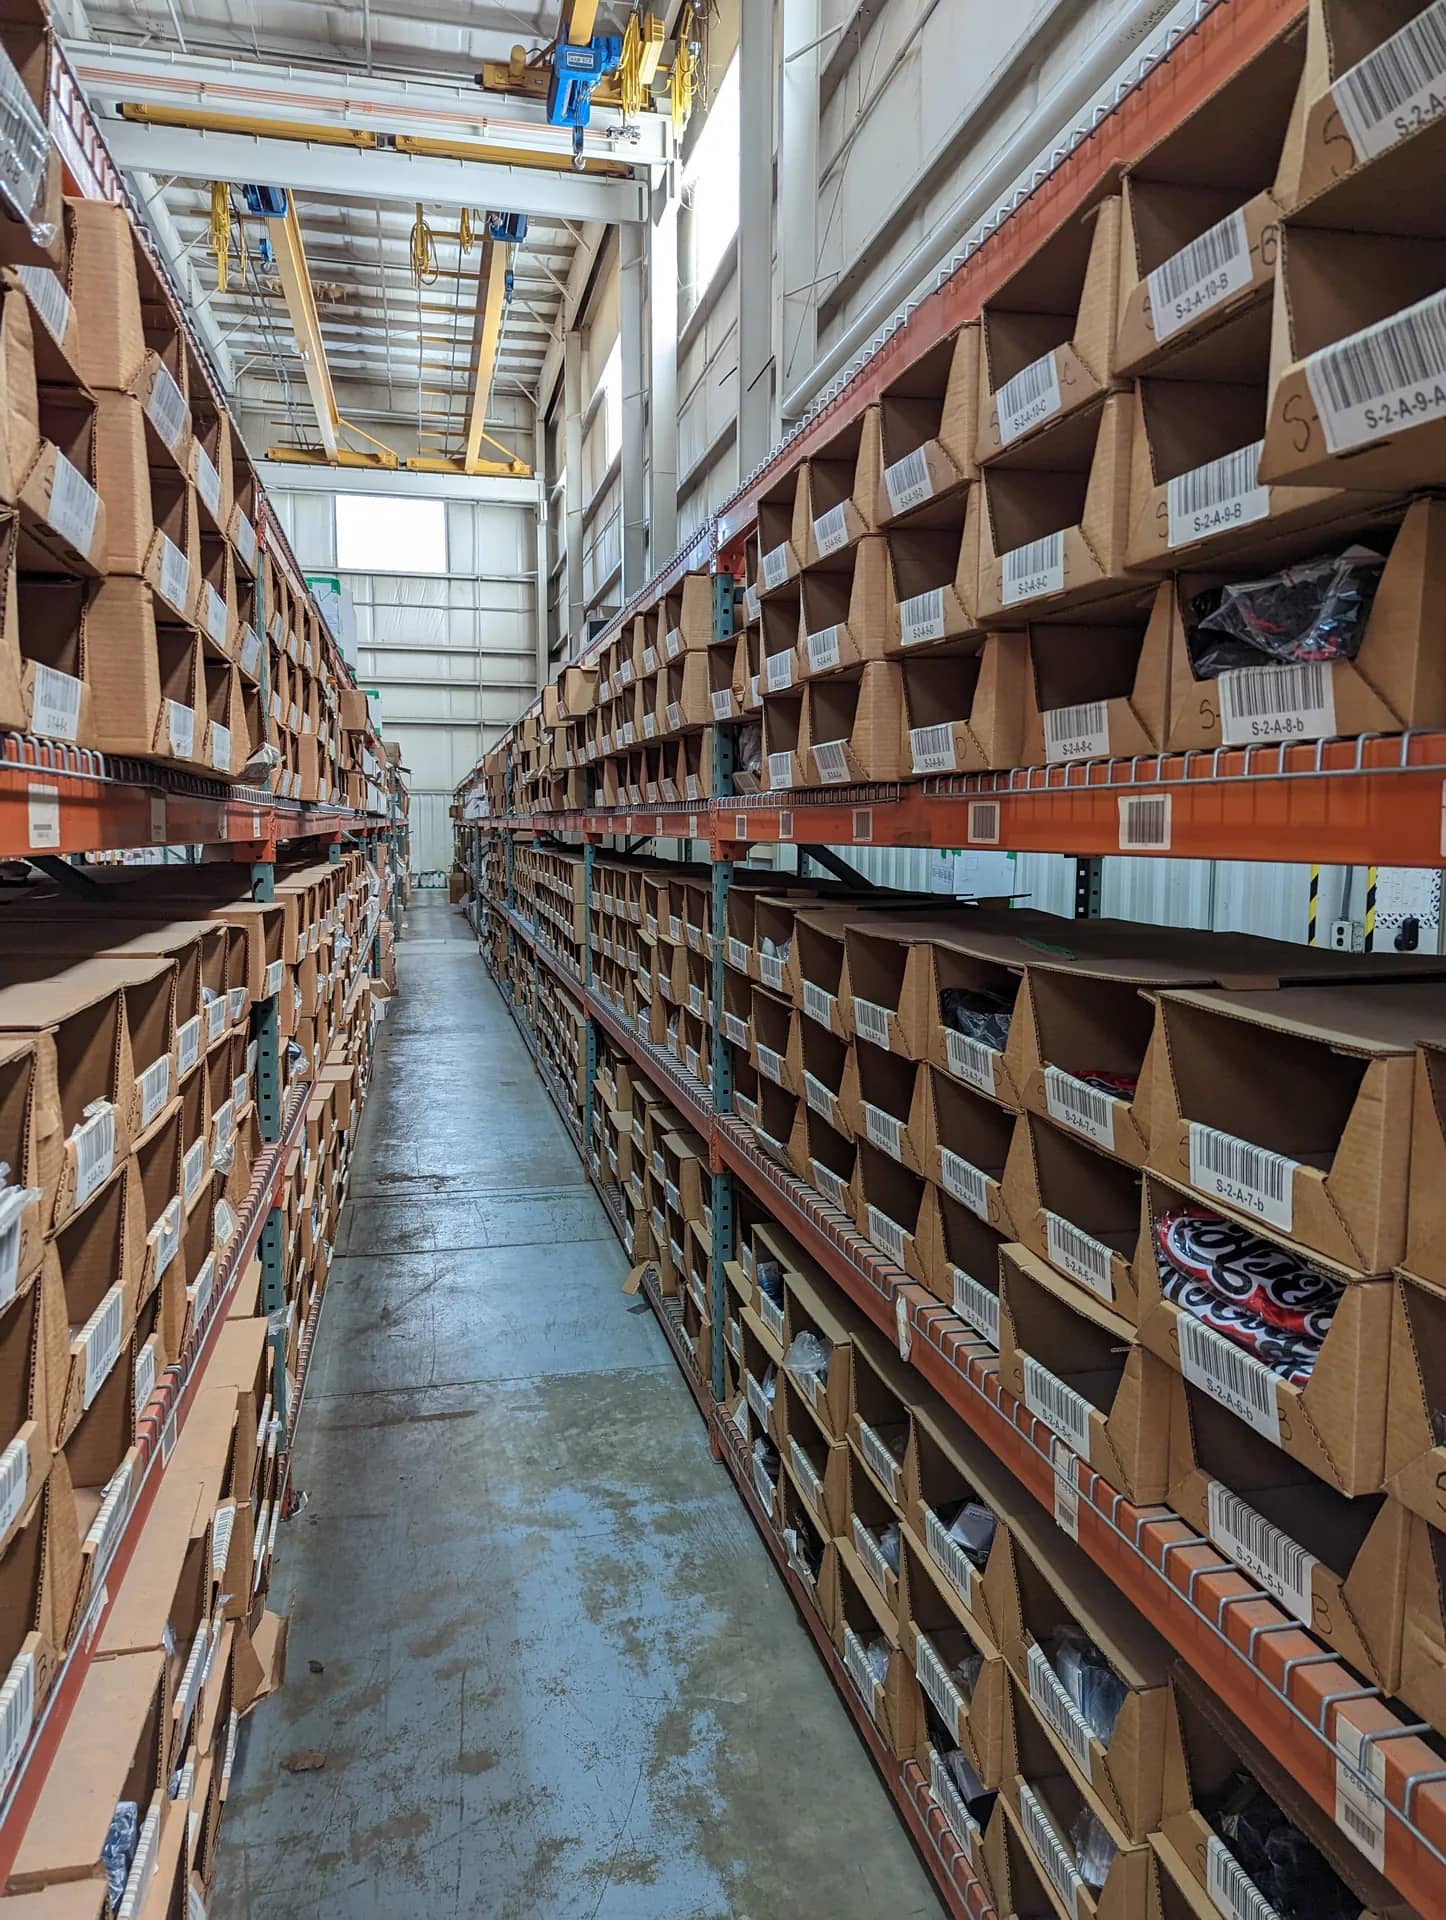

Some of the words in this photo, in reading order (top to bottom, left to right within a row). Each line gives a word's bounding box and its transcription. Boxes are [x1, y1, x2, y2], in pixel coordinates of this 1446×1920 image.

[1175, 272, 1229, 319] S-2-A-10-B
[1364, 384, 1446, 429] S-2-A-9-A
[1193, 503, 1242, 532] S-2-A-9-B
[1251, 717, 1304, 736] S-2-A-8-b
[1216, 1178, 1264, 1213] S-2-A-7-b
[1206, 1378, 1254, 1422] S-2-A-6-b
[1235, 1546, 1285, 1598] S-2-A-5-b
